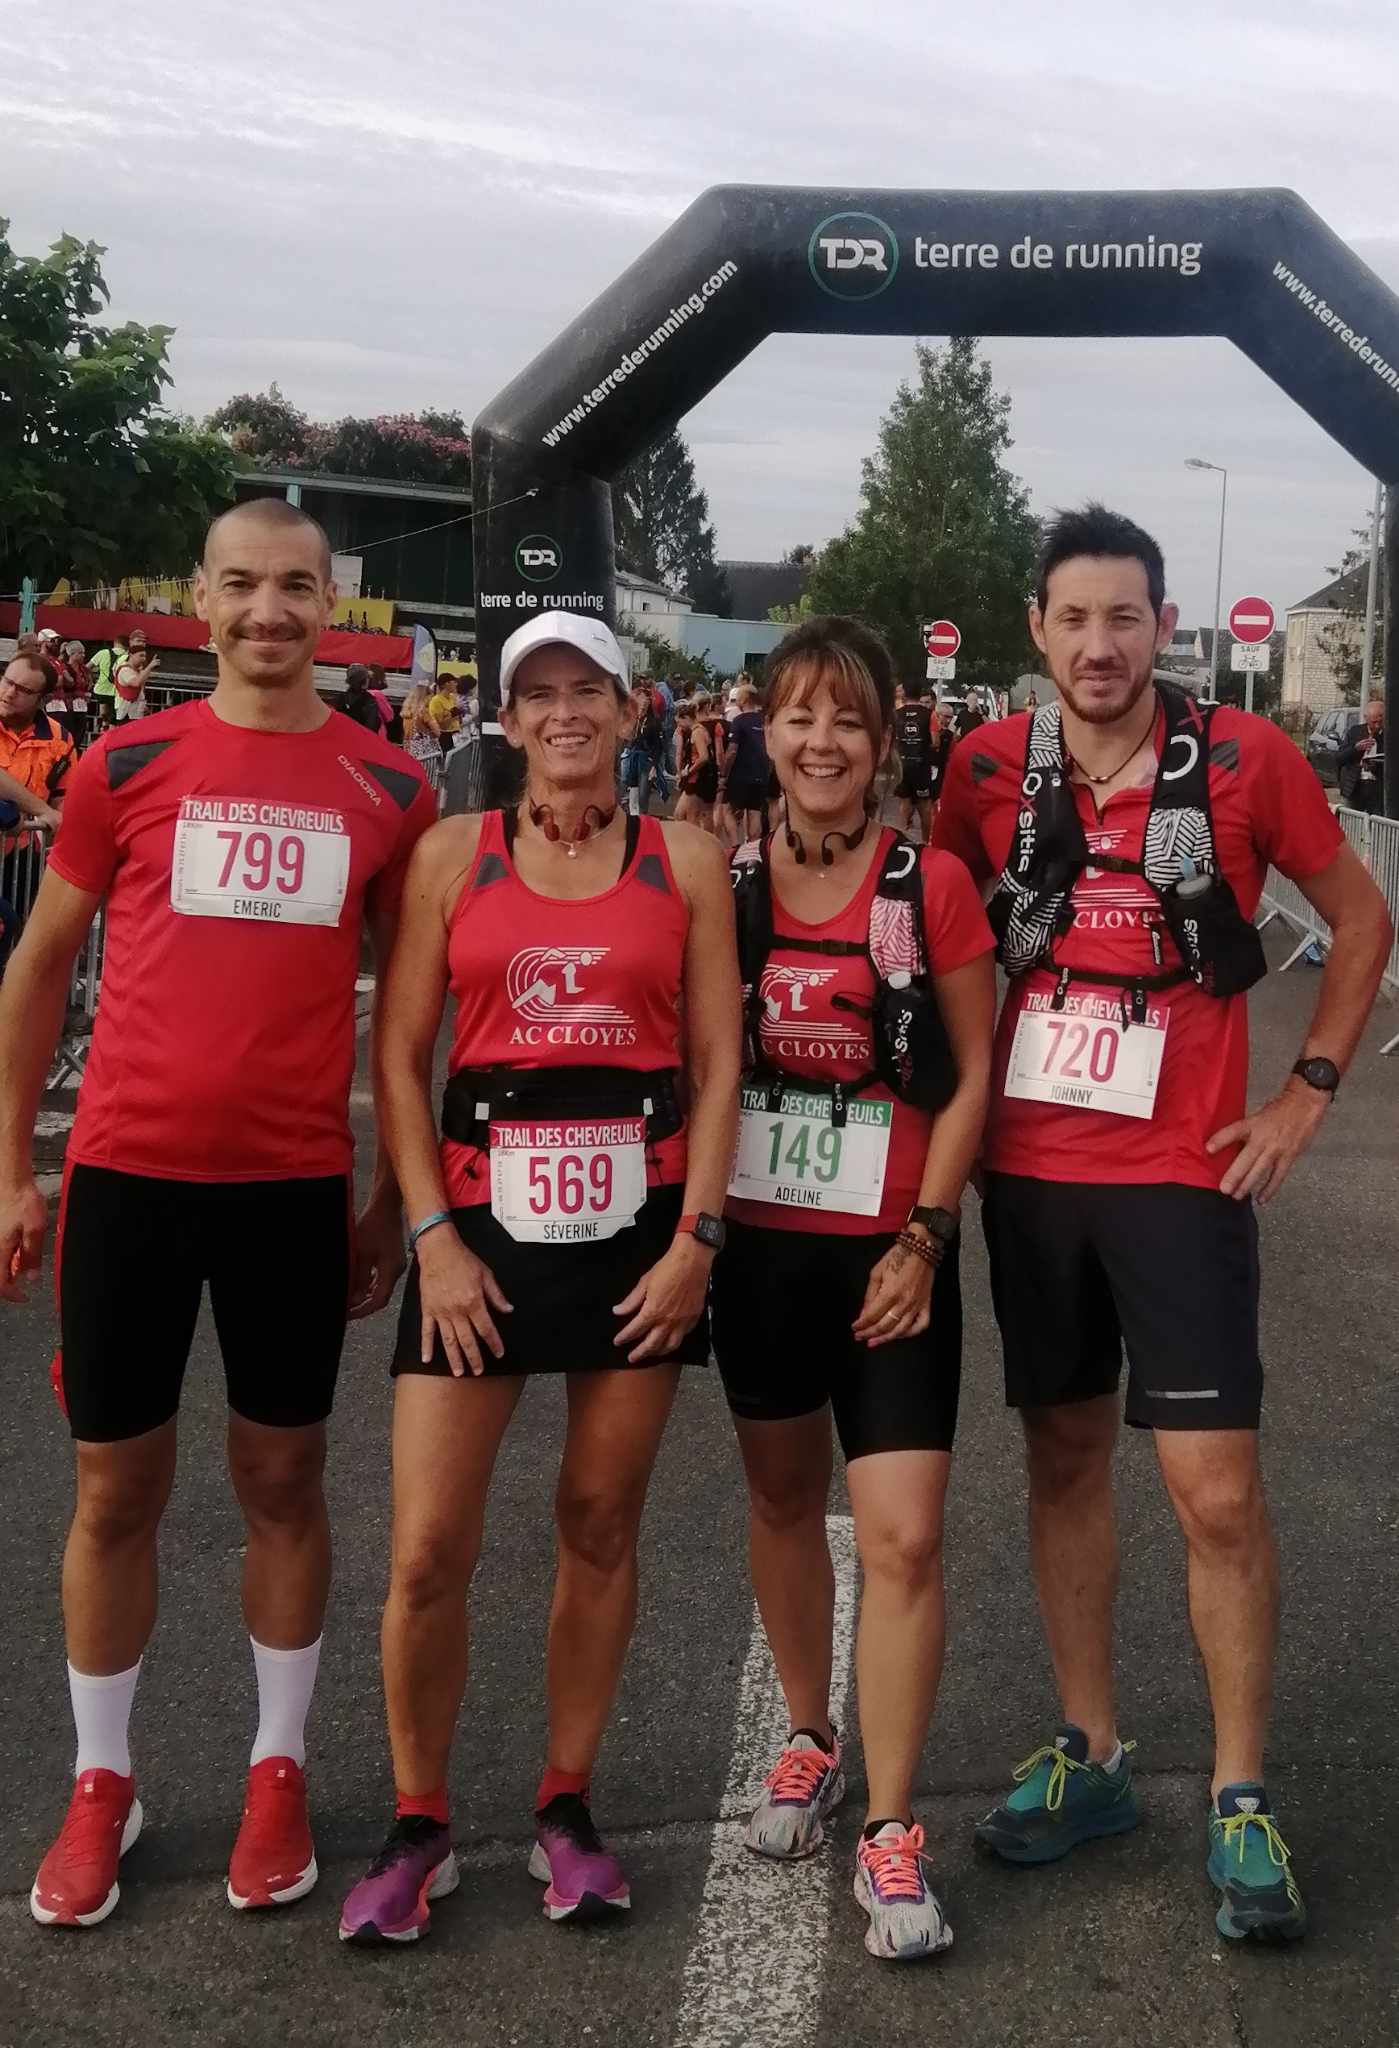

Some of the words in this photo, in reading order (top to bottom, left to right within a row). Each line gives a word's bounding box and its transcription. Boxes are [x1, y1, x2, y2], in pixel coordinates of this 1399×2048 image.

[820, 238, 888, 272] TDR
[914, 236, 998, 268] terre
[1010, 236, 1054, 268] de
[1065, 235, 1202, 276] running
[541, 260, 739, 448] www.terrederunning.com
[519, 549, 557, 566] TDR
[480, 592, 511, 608] terre
[515, 591, 537, 608] de
[542, 592, 604, 612] running
[337, 754, 381, 806] DIADORA
[184, 801, 224, 821] TRAIL
[228, 803, 256, 823] DES
[260, 806, 344, 833] CHEVREUILS
[216, 830, 305, 894] 799
[233, 899, 282, 918] EMERIC
[510, 1026, 542, 1044] AC
[547, 1026, 637, 1045] CLOYES
[778, 1040, 869, 1059] CLOYES
[1041, 1021, 1119, 1083] 720
[742, 1089, 769, 1111] TRA
[780, 1094, 802, 1114] DES
[805, 1098, 884, 1125] CHEEUILS
[1051, 1085, 1093, 1104] JOHNNY
[498, 1127, 532, 1147] TRAIL
[536, 1127, 562, 1146] DES
[565, 1123, 641, 1146] CHEVREUILS
[768, 1121, 842, 1183] 149
[529, 1153, 613, 1215] 569
[774, 1186, 823, 1206] ADELINE
